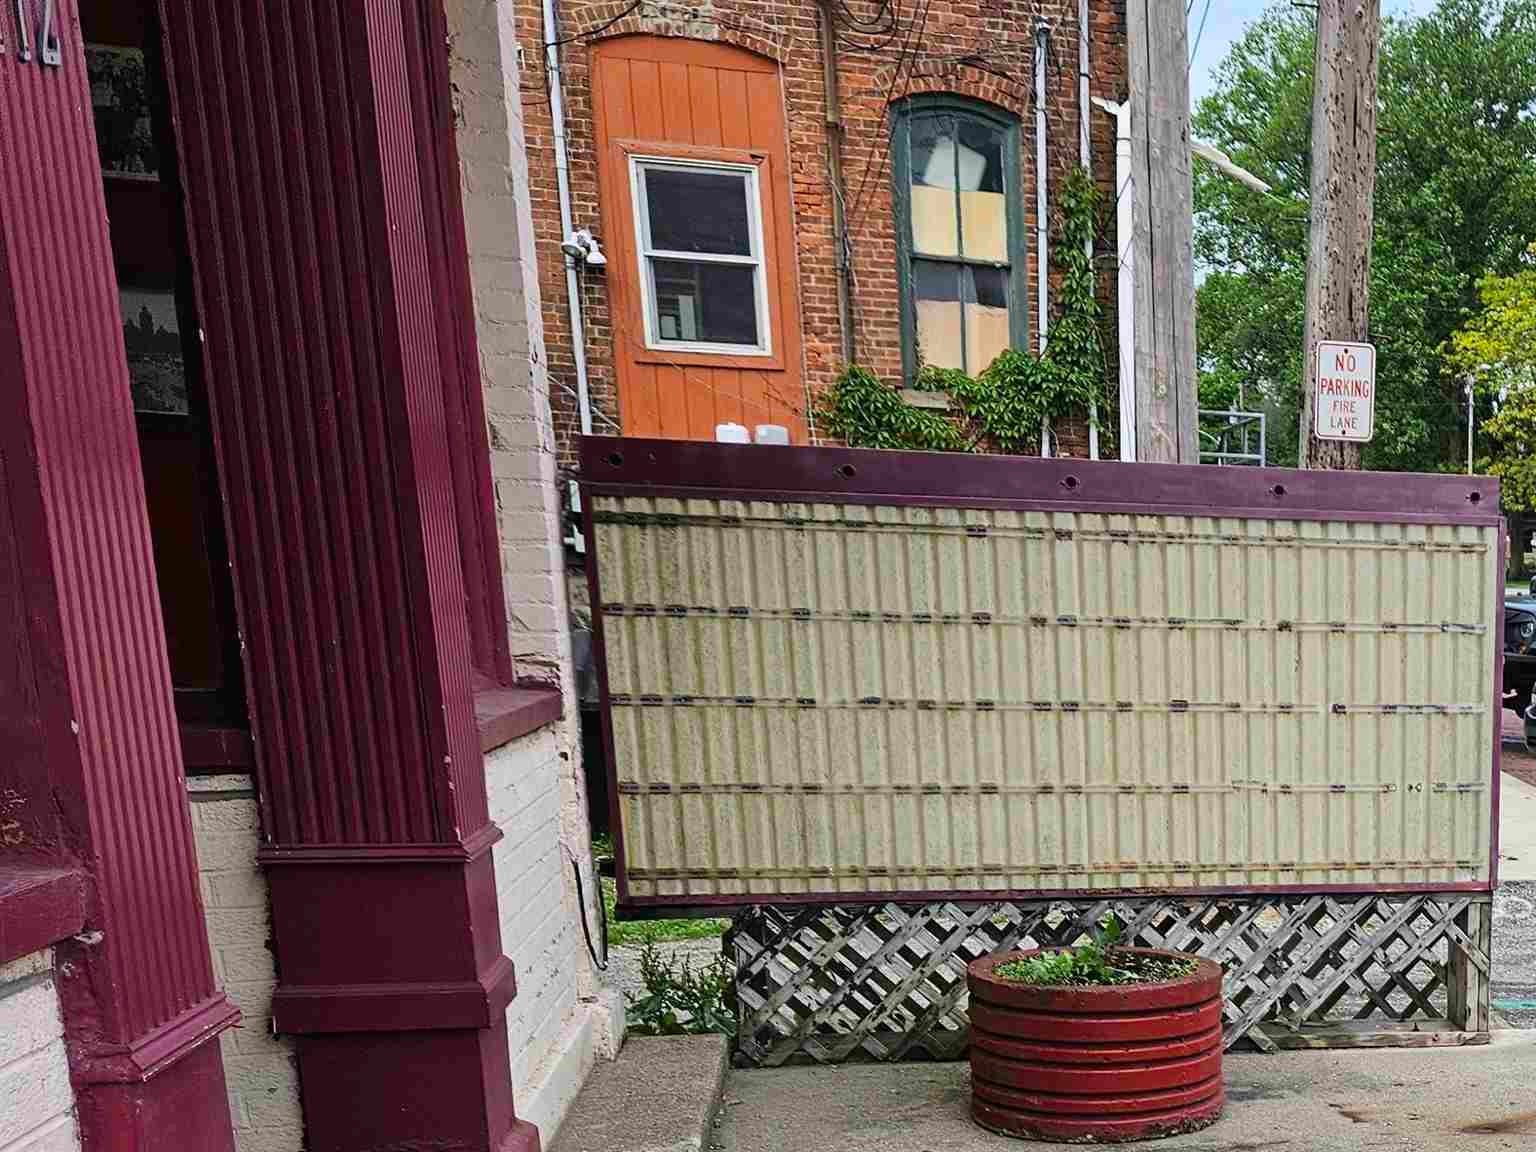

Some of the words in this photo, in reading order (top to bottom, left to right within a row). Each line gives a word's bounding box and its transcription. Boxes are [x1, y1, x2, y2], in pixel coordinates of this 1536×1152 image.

[1335, 353, 1356, 372] NO
[1320, 378, 1370, 399] PARKING
[1333, 400, 1357, 414] FIRE
[1330, 417, 1360, 430] LANE
